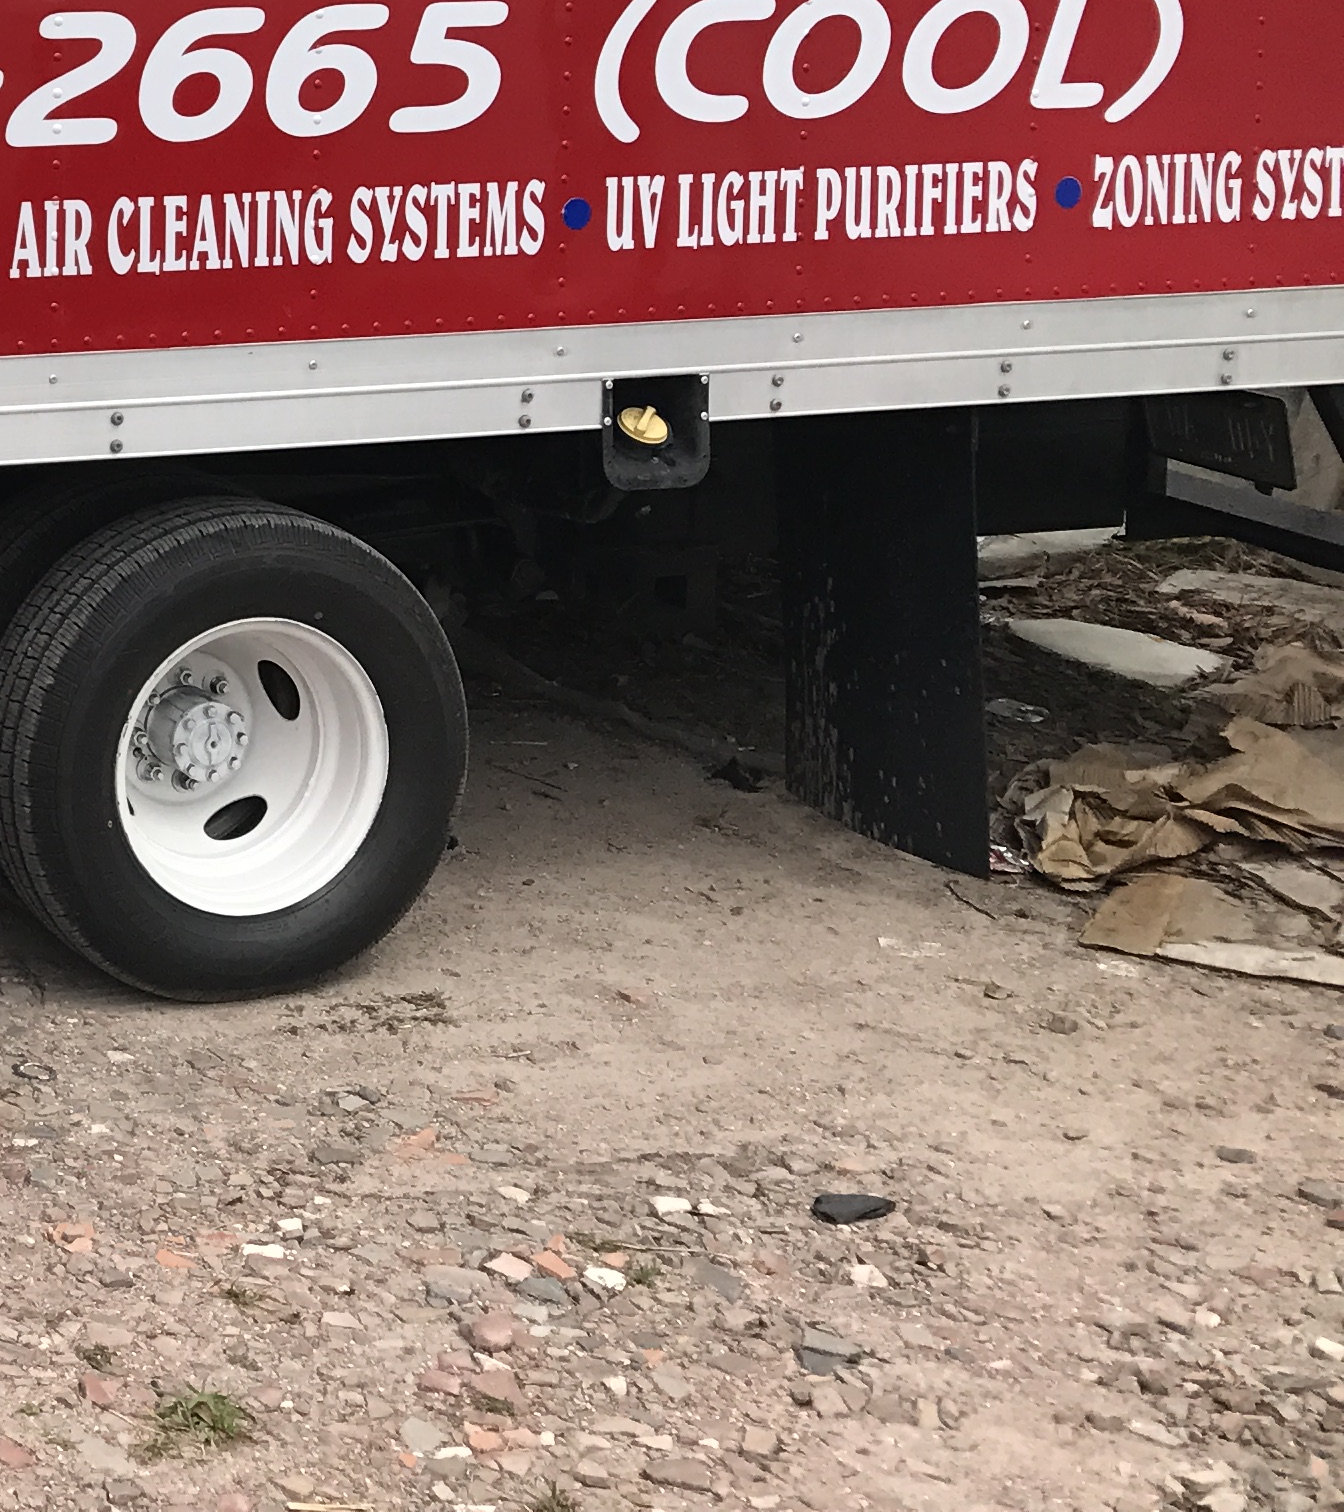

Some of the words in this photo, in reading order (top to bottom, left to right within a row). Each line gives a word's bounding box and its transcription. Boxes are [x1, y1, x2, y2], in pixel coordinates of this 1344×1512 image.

[10, 200, 92, 278] AIR
[108, 188, 333, 275] CLEANING
[347, 179, 545, 263] SYSTEMS
[606, 175, 665, 251] UV
[677, 166, 804, 249] LIGHT
[815, 159, 1037, 240] PURIFIERS
[1092, 151, 1242, 230] ZONING
